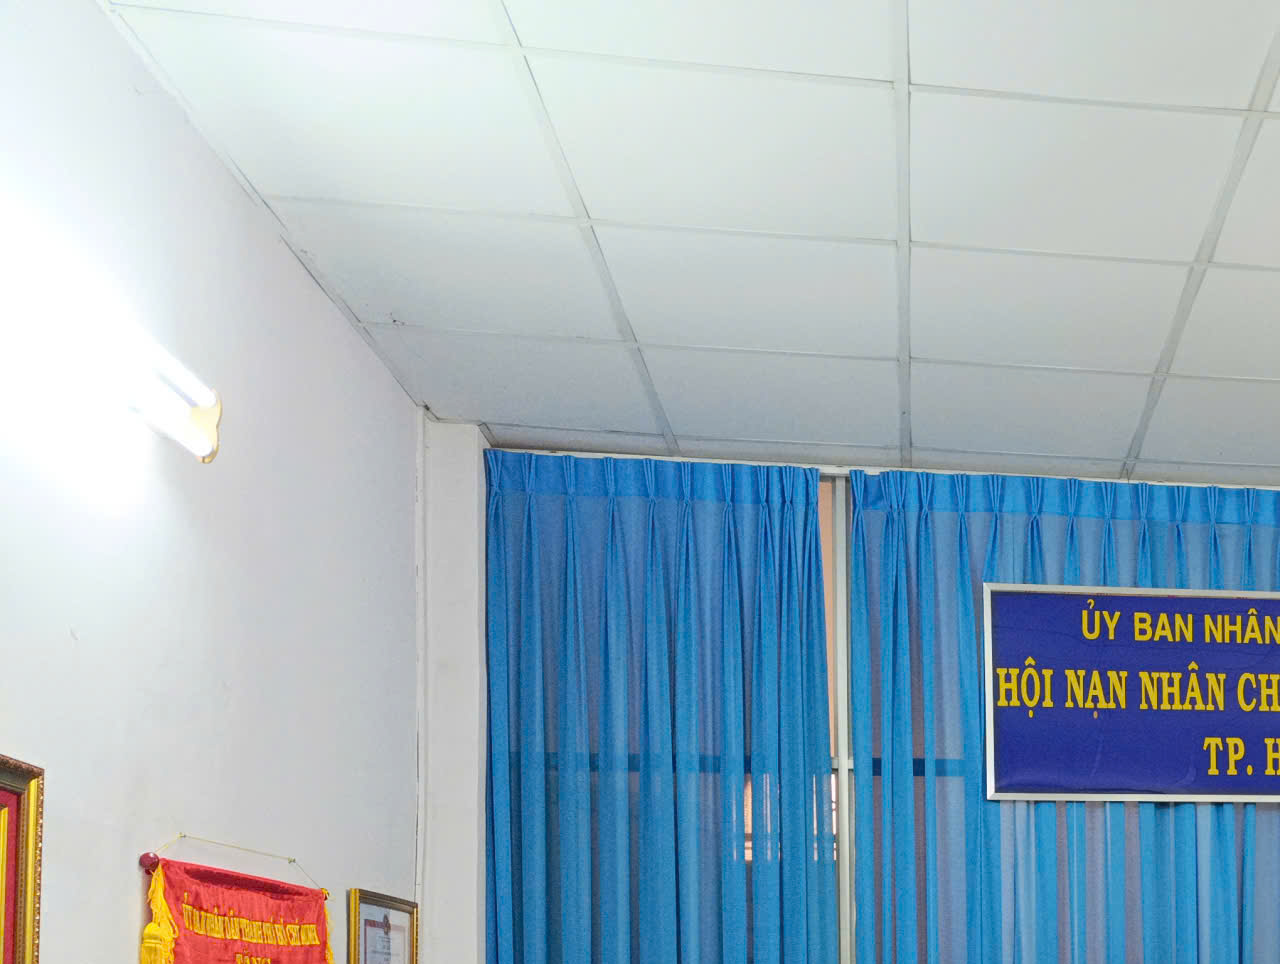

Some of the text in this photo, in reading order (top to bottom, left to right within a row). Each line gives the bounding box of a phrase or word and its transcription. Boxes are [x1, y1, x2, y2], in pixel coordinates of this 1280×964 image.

[1081, 599, 1121, 640] ỦY
[1133, 611, 1193, 643] BAN
[996, 656, 1054, 718] HỘI
[1064, 669, 1128, 719] NẠN
[1138, 660, 1227, 712] NHÂN
[1202, 737, 1253, 776] TP.
